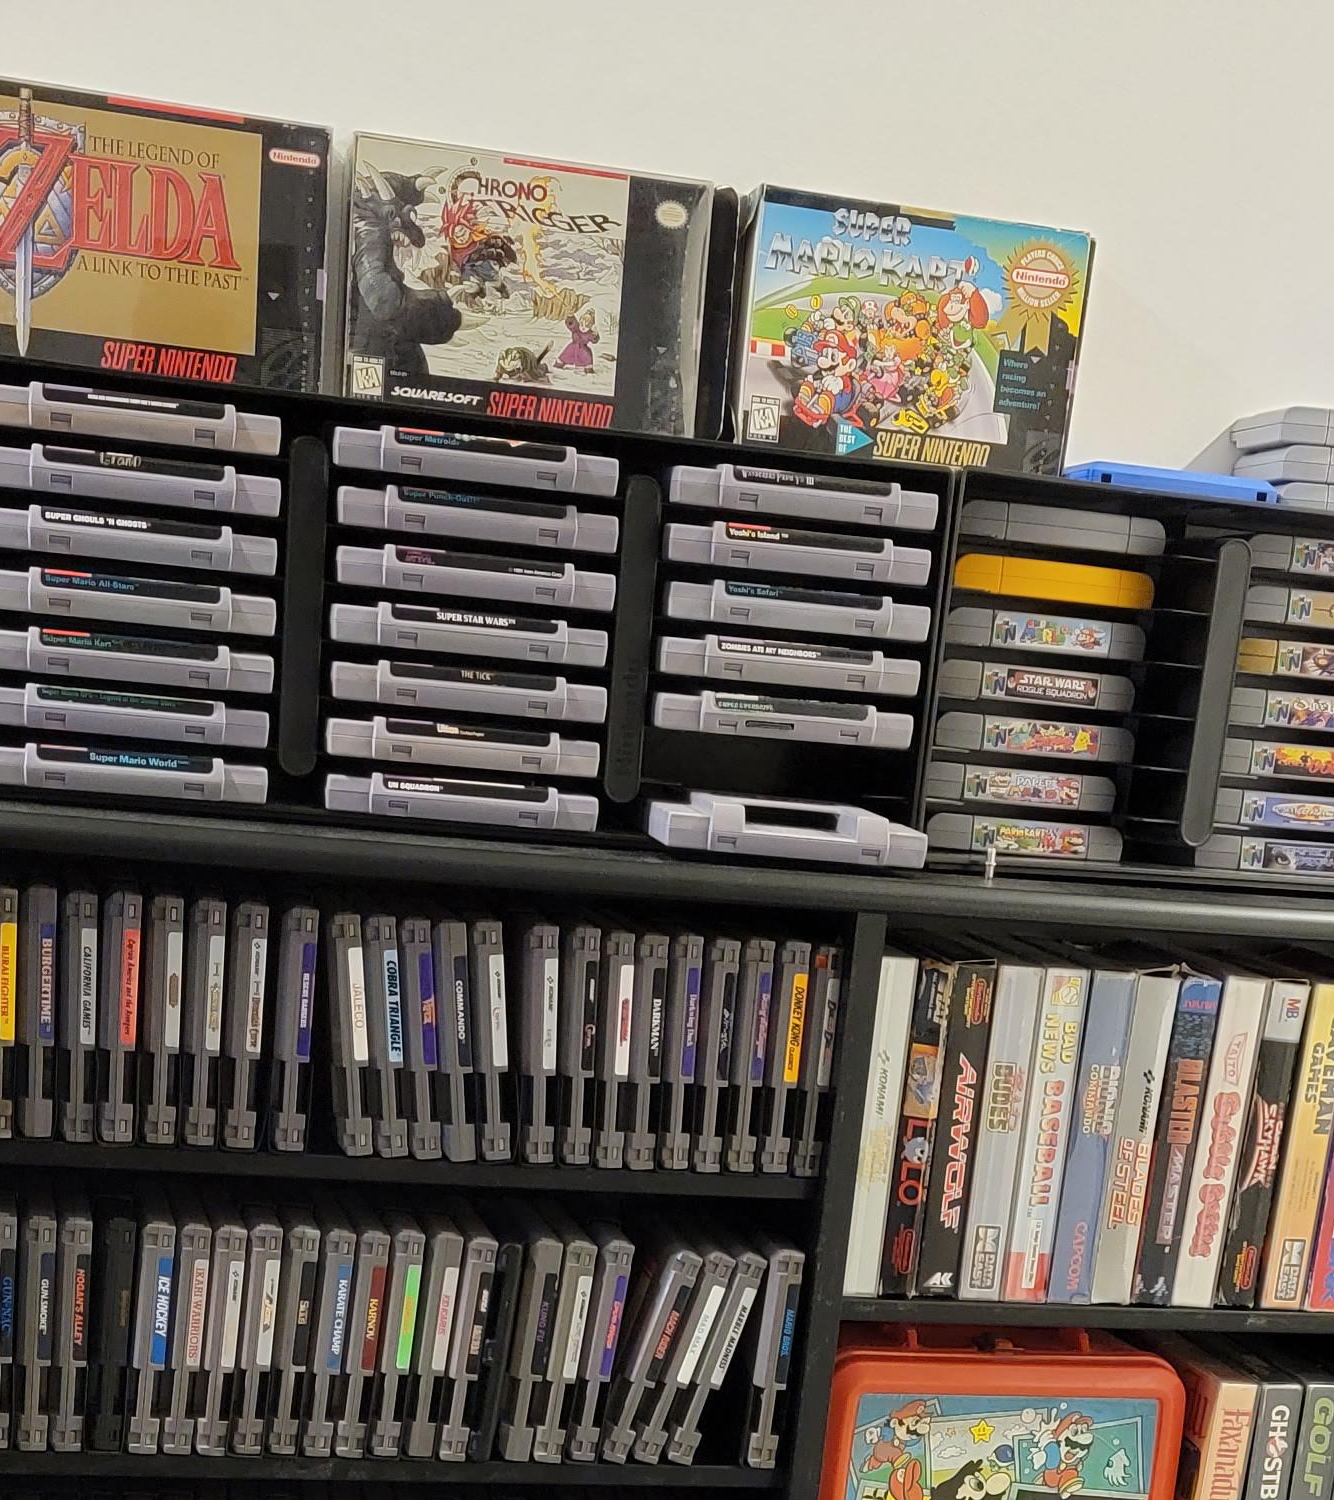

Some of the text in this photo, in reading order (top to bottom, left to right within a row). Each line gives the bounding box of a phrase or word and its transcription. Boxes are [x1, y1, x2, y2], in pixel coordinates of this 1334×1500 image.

[89, 135, 220, 169] THE LEGEND OF
[273, 151, 317, 165] Nintendo
[449, 169, 548, 204] CHRONO
[467, 199, 621, 236] TRIGGER
[833, 207, 912, 246] SUPER
[77, 255, 242, 291] A LINK TO THE PAST
[766, 232, 967, 293] MARIO KART
[1016, 270, 1067, 287] Nintendo
[101, 341, 238, 384] SUPER NINTENDO
[1003, 358, 1029, 370] Where
[391, 386, 481, 406] SQUARESOFT
[487, 392, 614, 429] SUPER NINTENDO
[1000, 386, 1047, 398] becomes an
[873, 431, 990, 467] SUPER NINTENDO
[461, 670, 491, 681] THE TICK
[89, 752, 178, 768] Super Mario World
[81, 946, 92, 1029] CALIFORNIA GAMES
[386, 959, 401, 1052] COBRA TRIANGLE
[455, 980, 466, 1040] COMMANDO
[650, 998, 662, 1051] DARKMAN
[1039, 1012, 1061, 1074] NEWS
[1059, 1020, 1079, 1064] BAD
[1304, 1041, 1325, 1105] GAMES
[940, 1052, 977, 1231] AIRWOLF
[1030, 1079, 1065, 1207] BASEBALL
[1108, 1138, 1136, 1229] OF STEEL
[1126, 1142, 1149, 1226] BLADES
[1066, 1222, 1088, 1290] CAPCOM
[155, 1275, 171, 1338] ICE HOCKEY
[331, 1279, 348, 1356] KARATE CHAMP
[366, 1298, 378, 1340] KARNOV
[717, 1305, 748, 1371] MARBLE MADNESS
